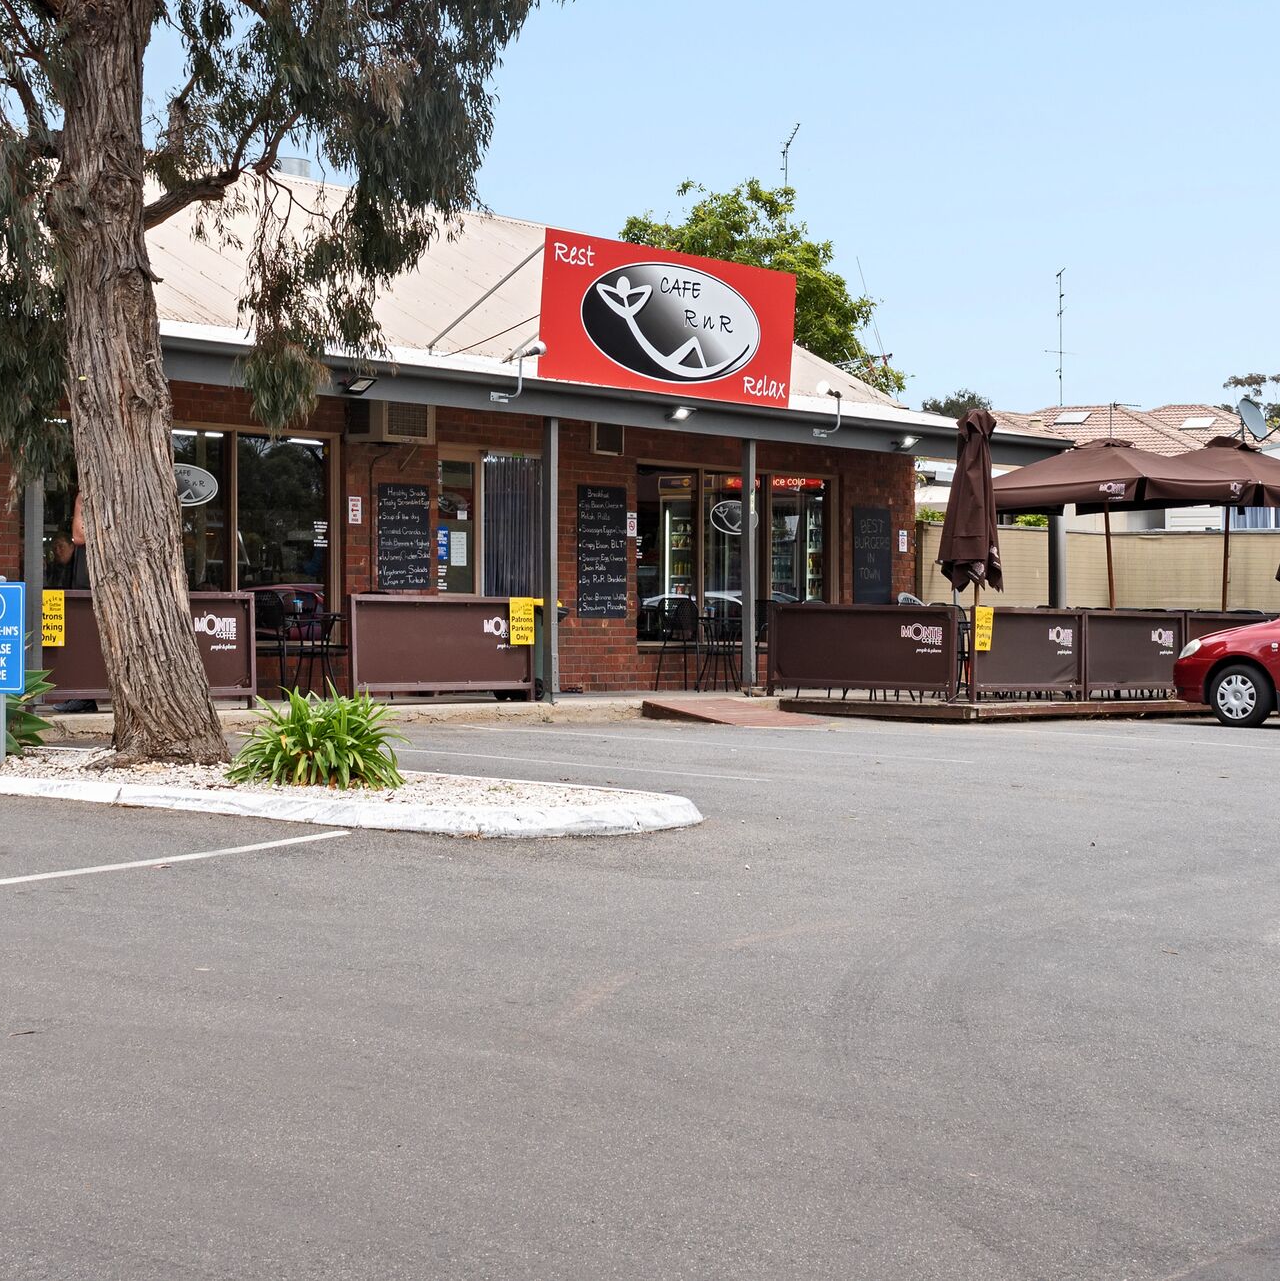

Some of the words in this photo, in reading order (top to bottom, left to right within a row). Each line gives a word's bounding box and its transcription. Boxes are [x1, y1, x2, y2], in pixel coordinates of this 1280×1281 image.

[553, 242, 596, 267] Rest
[660, 276, 701, 299] CAFE
[743, 375, 786, 399] Relax
[772, 476, 786, 487] ice
[381, 512, 396, 522] Soup
[860, 518, 886, 534] BEST
[854, 535, 891, 551] BURGERS
[867, 552, 876, 563] IN
[859, 567, 881, 581] TOWN
[41, 612, 63, 621] trons
[41, 623, 63, 632] rking
[194, 613, 237, 636] MONTE
[511, 624, 534, 633] Parking
[215, 631, 237, 640] COFFEE
[901, 623, 943, 641] MONTE
[921, 637, 943, 646] COFFEE
